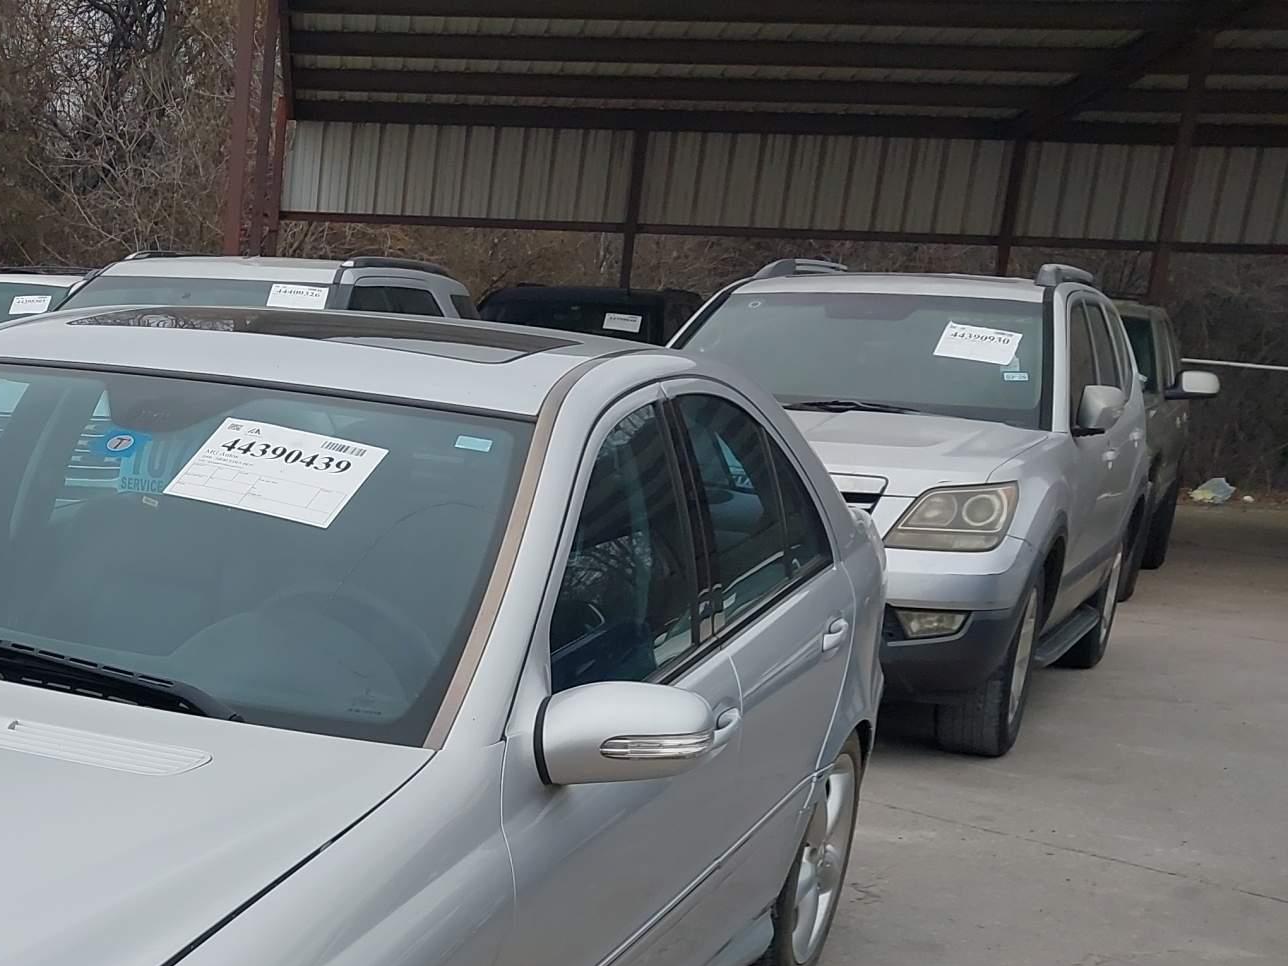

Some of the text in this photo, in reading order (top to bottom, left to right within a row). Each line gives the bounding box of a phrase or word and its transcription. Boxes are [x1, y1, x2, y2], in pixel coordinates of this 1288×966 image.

[951, 331, 1010, 345] 44390930
[221, 438, 352, 474] 44390439
[120, 476, 164, 493] SERVICE
